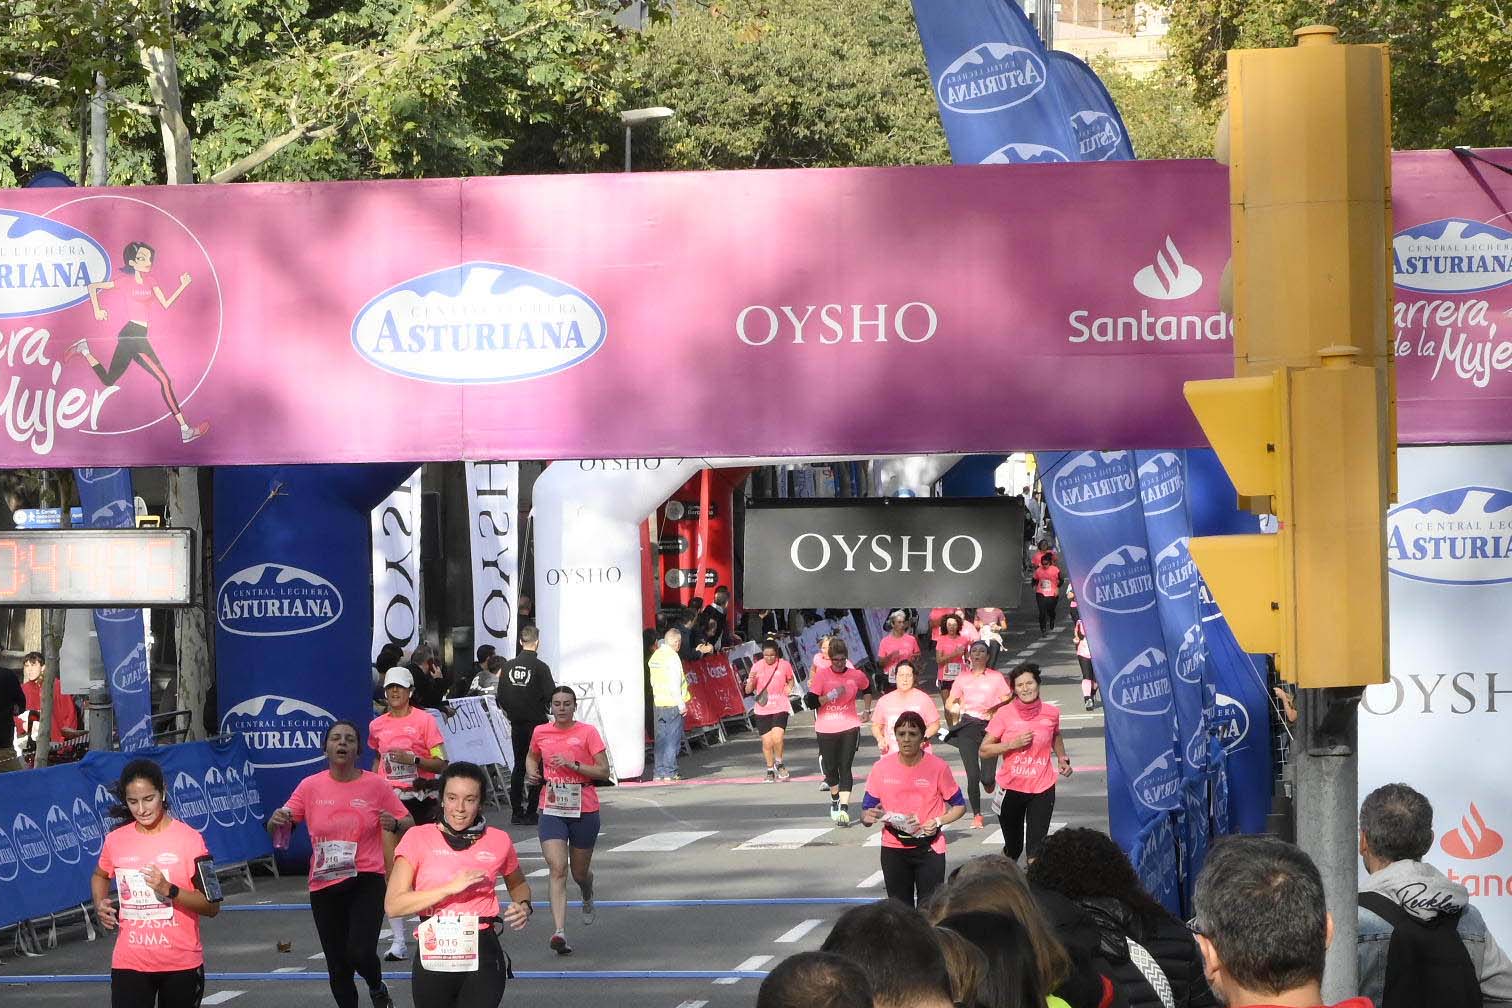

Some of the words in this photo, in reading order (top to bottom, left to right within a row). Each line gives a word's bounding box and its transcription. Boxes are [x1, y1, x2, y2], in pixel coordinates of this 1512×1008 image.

[1464, 243, 1512, 252] LECHER
[736, 302, 937, 345] OYSHO
[1069, 309, 1234, 343] Santand
[1393, 299, 1490, 328] arrera
[372, 309, 587, 353] ASTURIANA
[1418, 330, 1435, 357] la
[1431, 327, 1512, 388] Muje
[1415, 521, 1482, 531] CENTRAL
[790, 533, 983, 573] OYSHO
[546, 567, 622, 586] OYSHO
[221, 593, 333, 620] ASTURIANA
[234, 589, 277, 597] CENTRAL
[280, 588, 329, 596] LECHERA
[1361, 672, 1512, 716] OYSH
[281, 719, 330, 728] LECHERA
